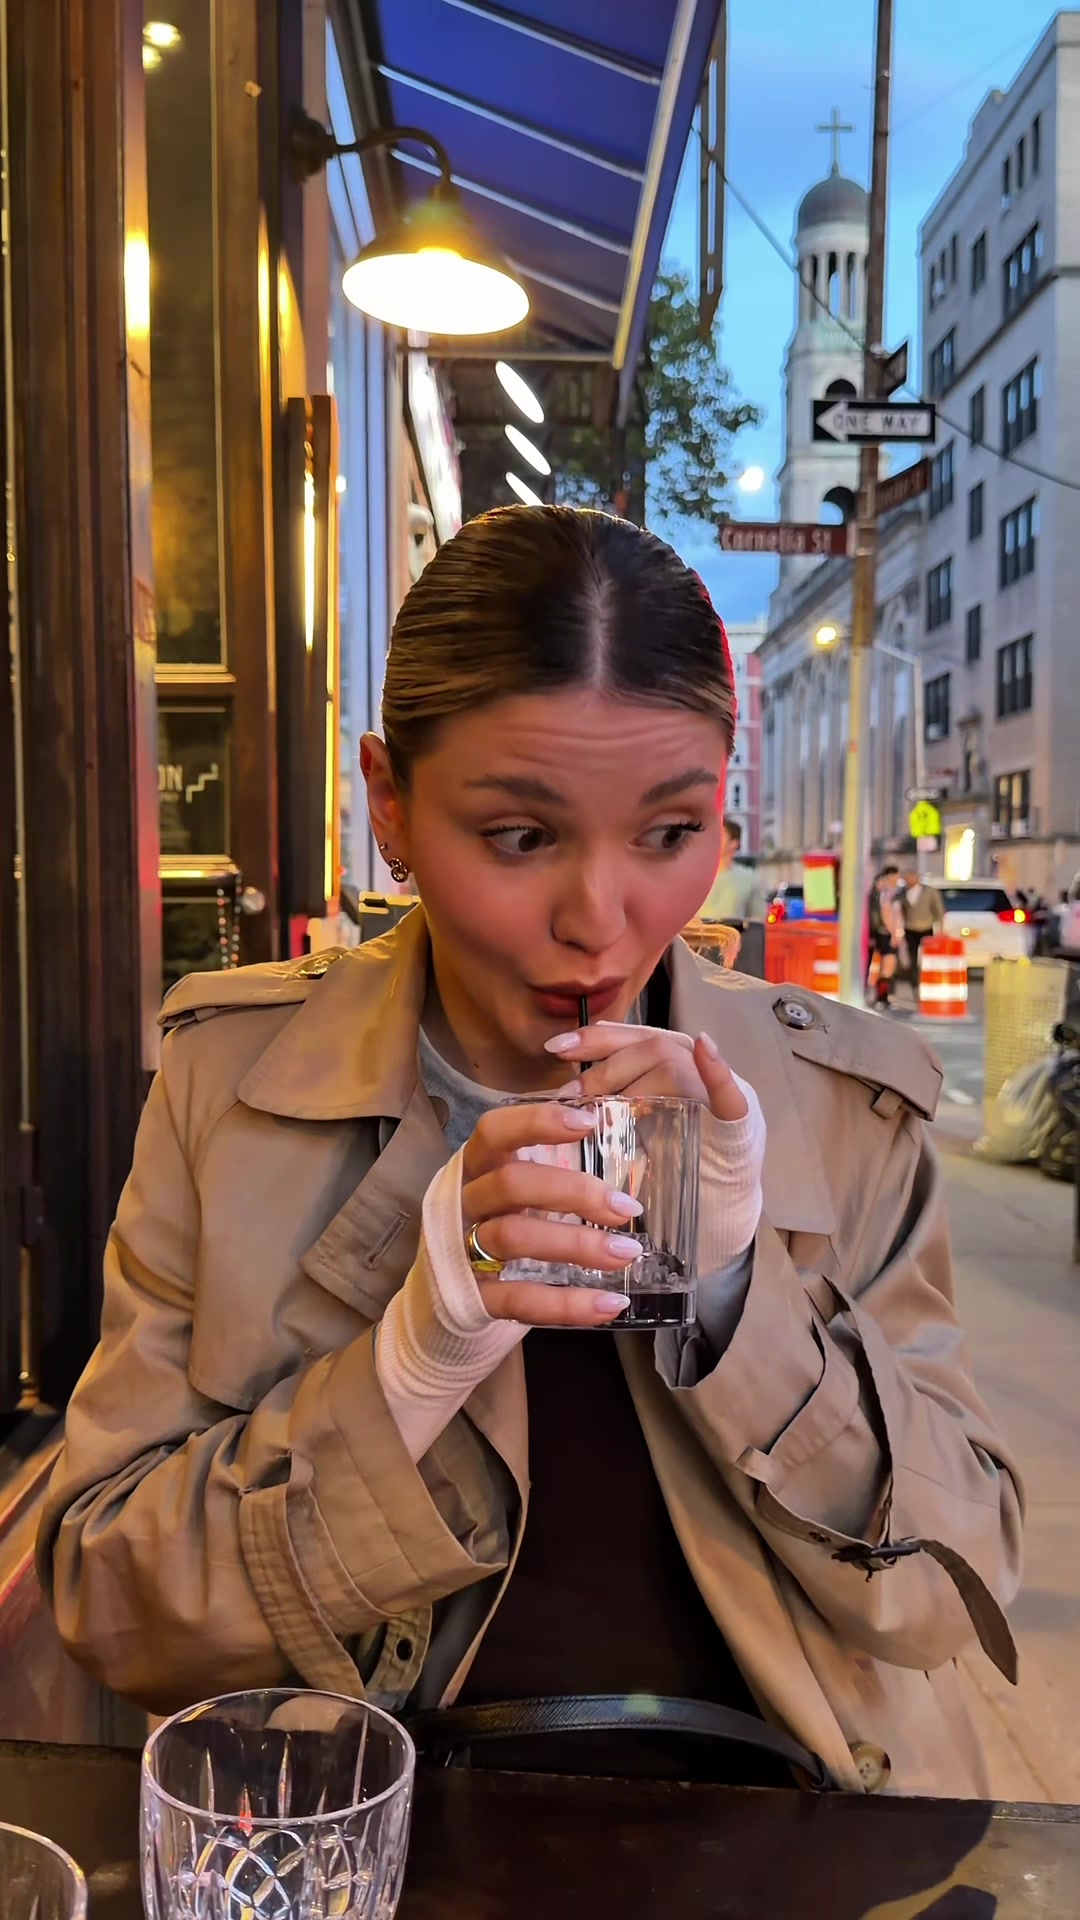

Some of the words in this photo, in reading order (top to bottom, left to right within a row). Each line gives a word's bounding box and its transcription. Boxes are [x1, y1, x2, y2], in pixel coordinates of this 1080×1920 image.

[833, 411, 872, 433] ONE
[881, 414, 921, 433] WAY
[721, 526, 806, 552] Cornelia
[812, 528, 832, 553] St
